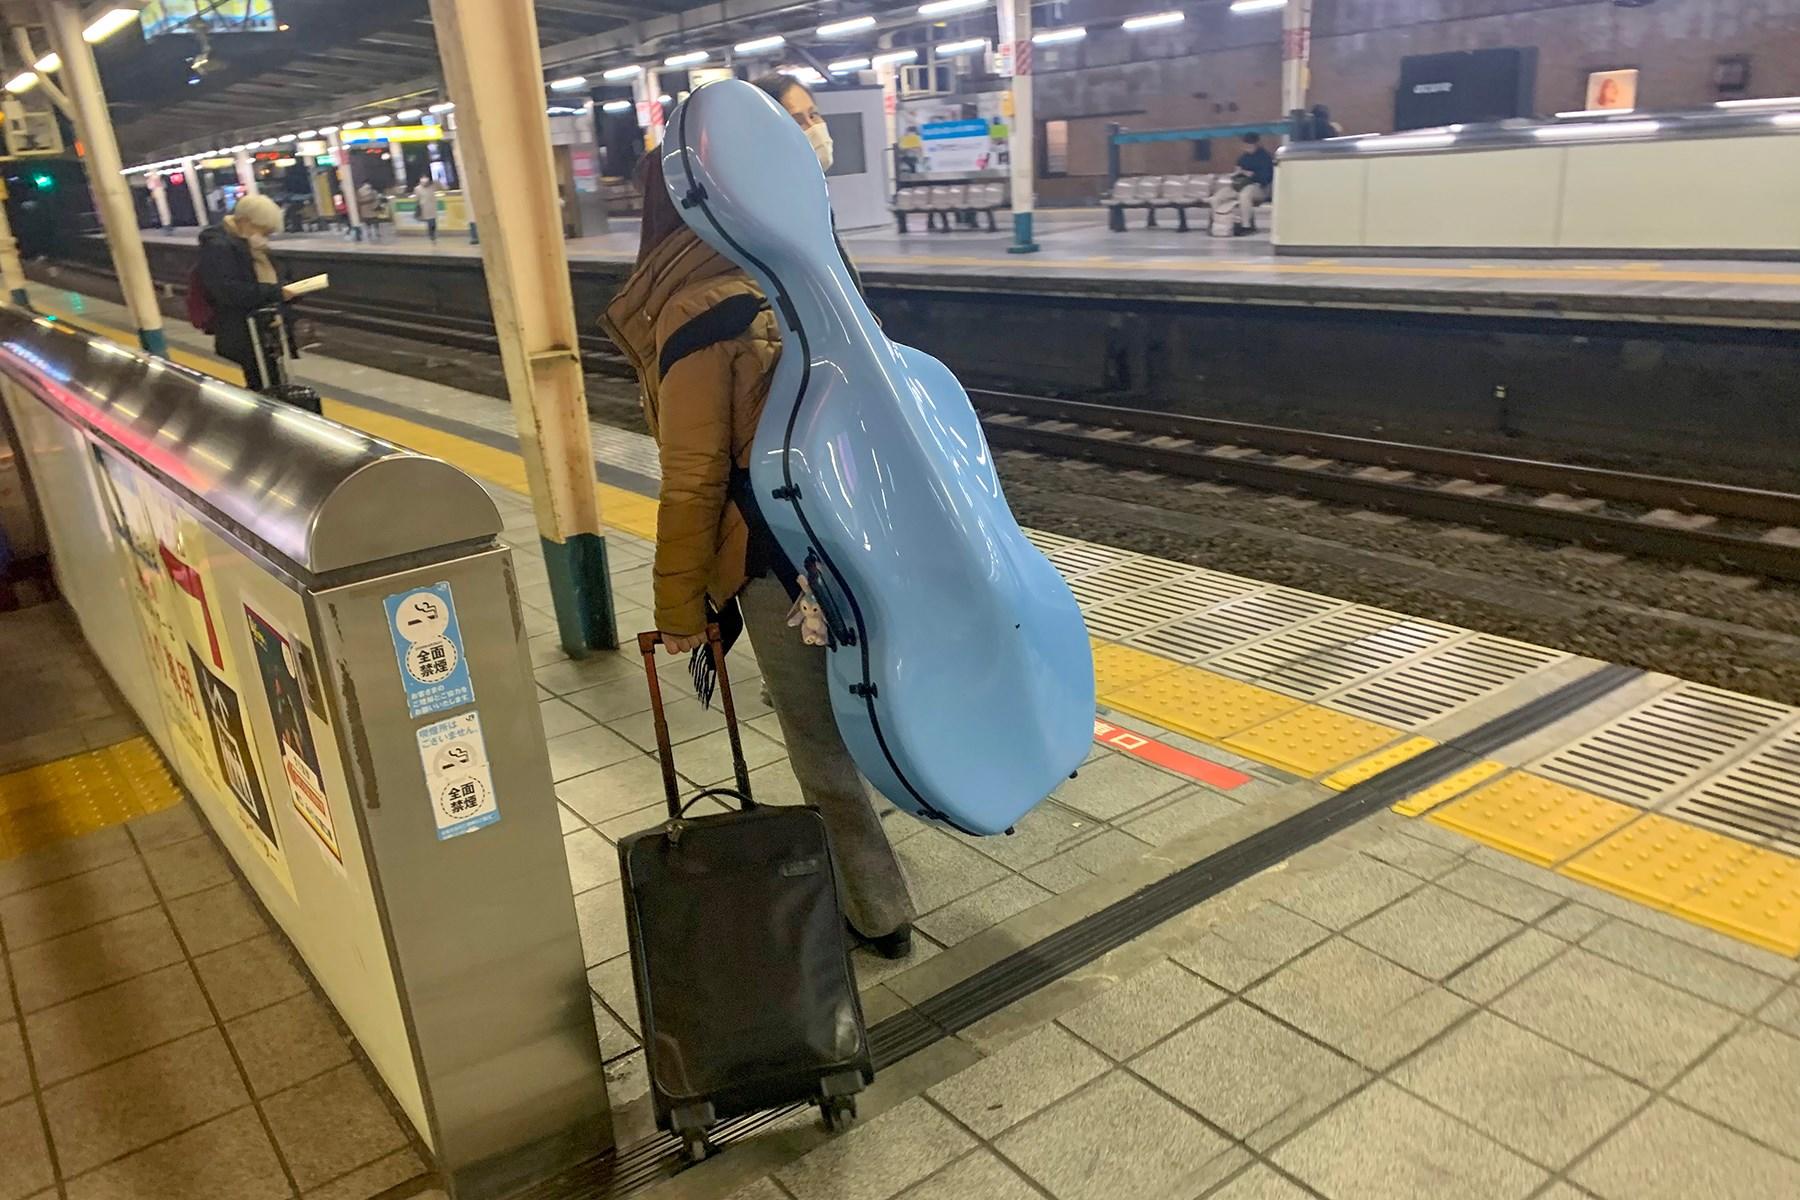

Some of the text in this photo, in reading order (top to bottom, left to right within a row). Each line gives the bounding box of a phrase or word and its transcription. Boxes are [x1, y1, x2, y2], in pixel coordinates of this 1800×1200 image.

[417, 645, 445, 664] 全面
[420, 659, 448, 677] 禁煙
[448, 781, 475, 801] 全面
[450, 795, 478, 814] 禁煙
